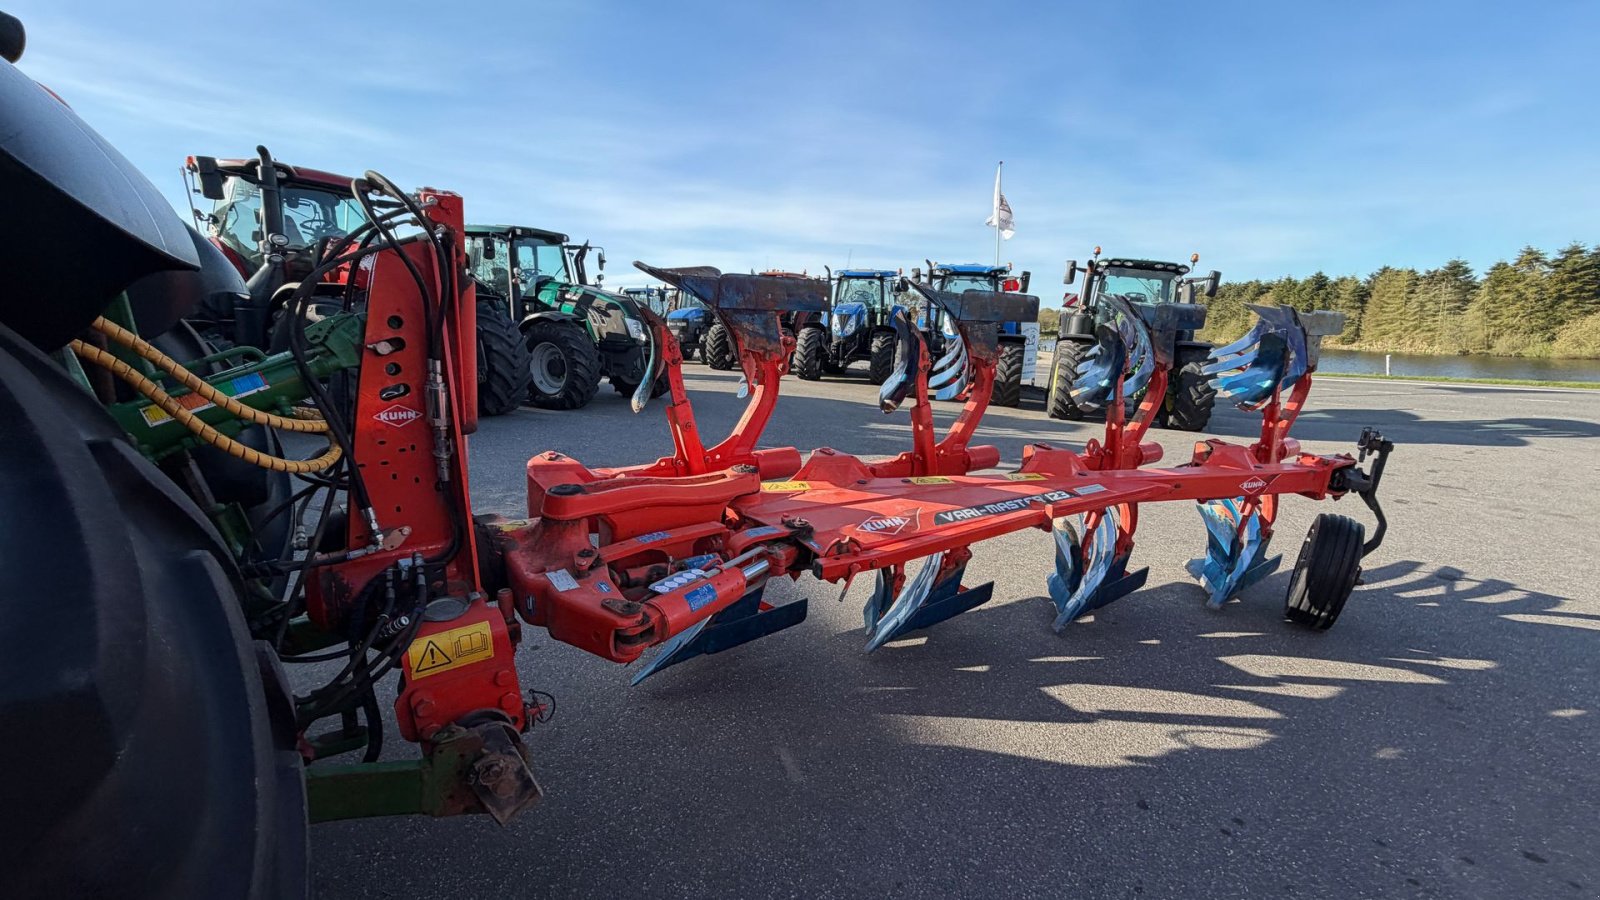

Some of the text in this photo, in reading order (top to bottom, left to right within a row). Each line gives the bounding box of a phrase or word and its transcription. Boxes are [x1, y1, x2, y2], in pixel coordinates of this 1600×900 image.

[380, 411, 416, 420] KUHN
[1044, 490, 1071, 501] 123
[862, 516, 905, 531] KUHN
